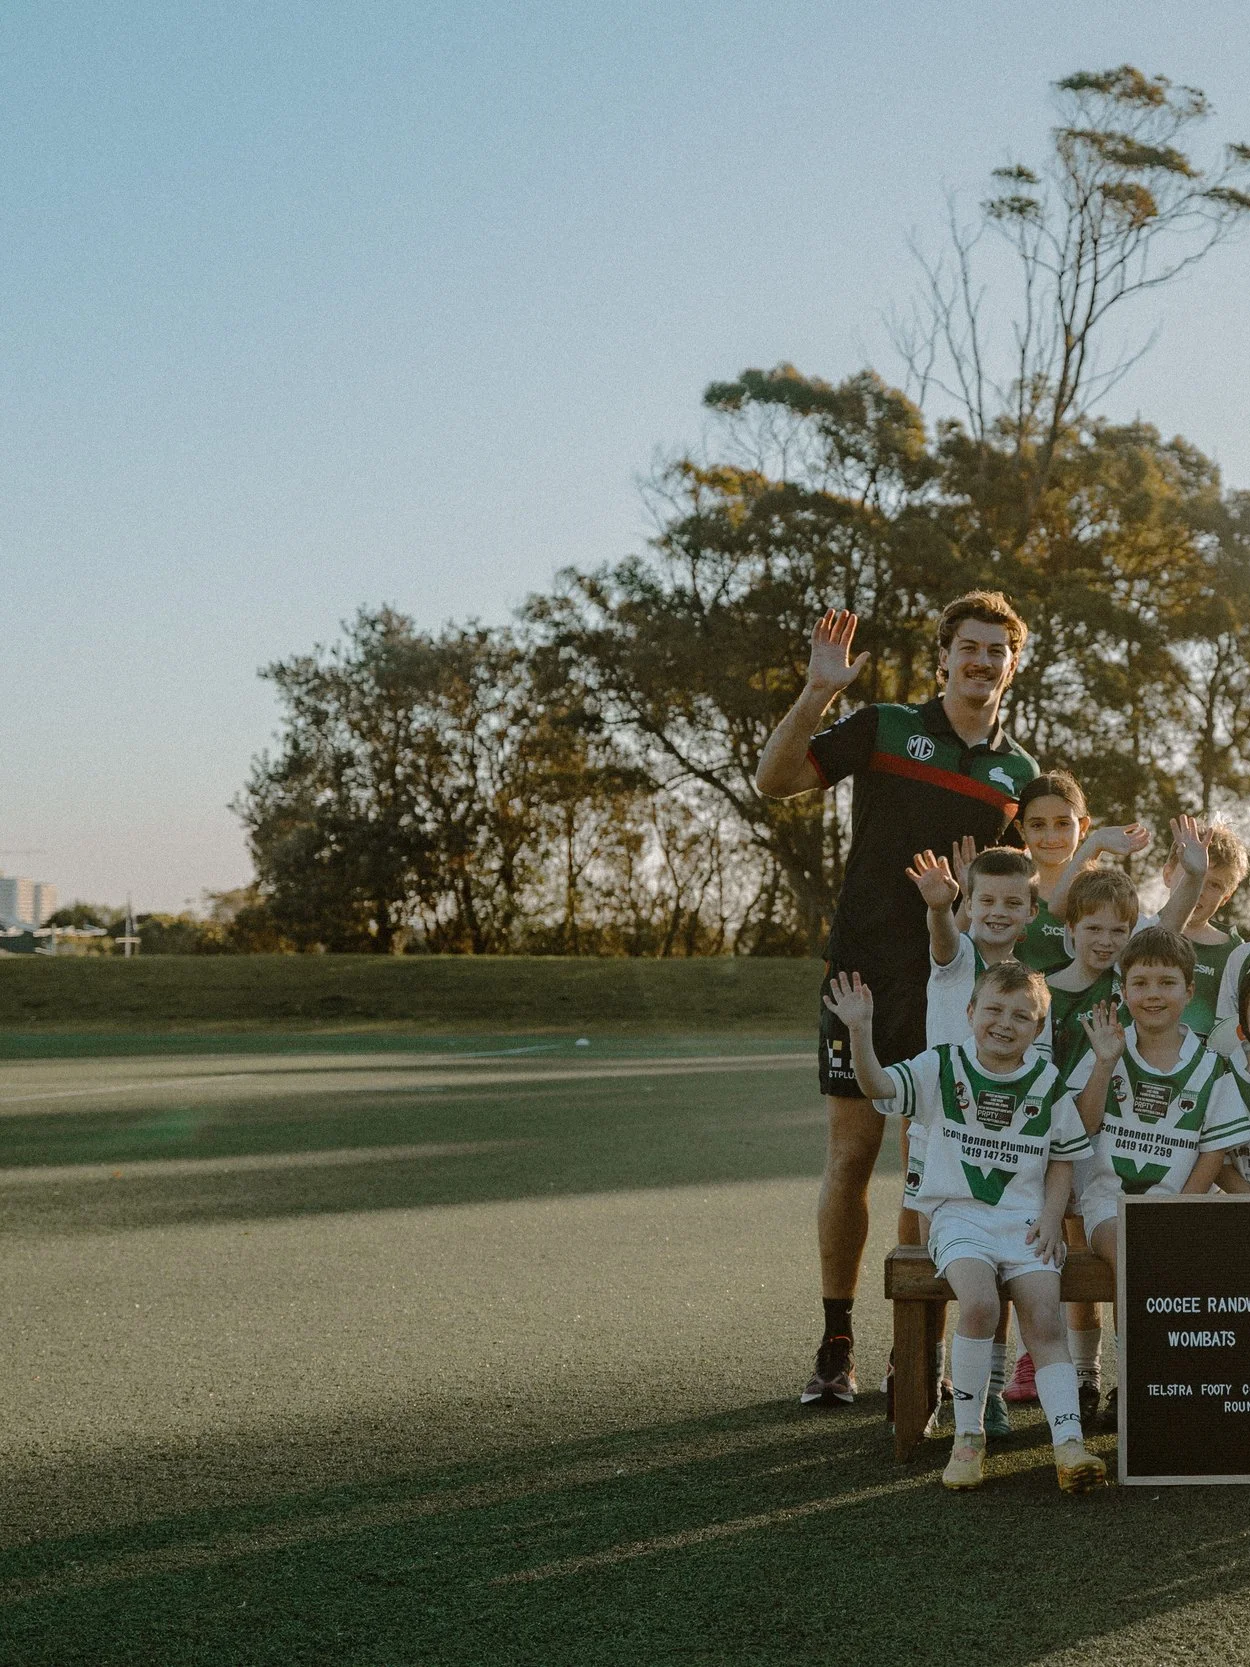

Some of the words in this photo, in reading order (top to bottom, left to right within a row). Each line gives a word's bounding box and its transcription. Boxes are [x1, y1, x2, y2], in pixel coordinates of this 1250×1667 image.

[908, 736, 934, 759] MG
[1053, 927, 1065, 936] CS
[1101, 1123, 1117, 1135] cott
[1118, 1127, 1155, 1142] Bennett
[962, 1133, 1000, 1149] Bennett
[1115, 1138, 1136, 1151] 0419
[1138, 1143, 1153, 1154] 147
[1154, 1145, 1172, 1158] 259
[984, 1150, 999, 1161] 147
[1000, 1152, 1019, 1164] 259
[1146, 1297, 1201, 1313] COOGEE
[1168, 1330, 1236, 1347] WOMBATS
[1147, 1383, 1193, 1396] TELSTRA
[1201, 1384, 1232, 1396] FOOTY
